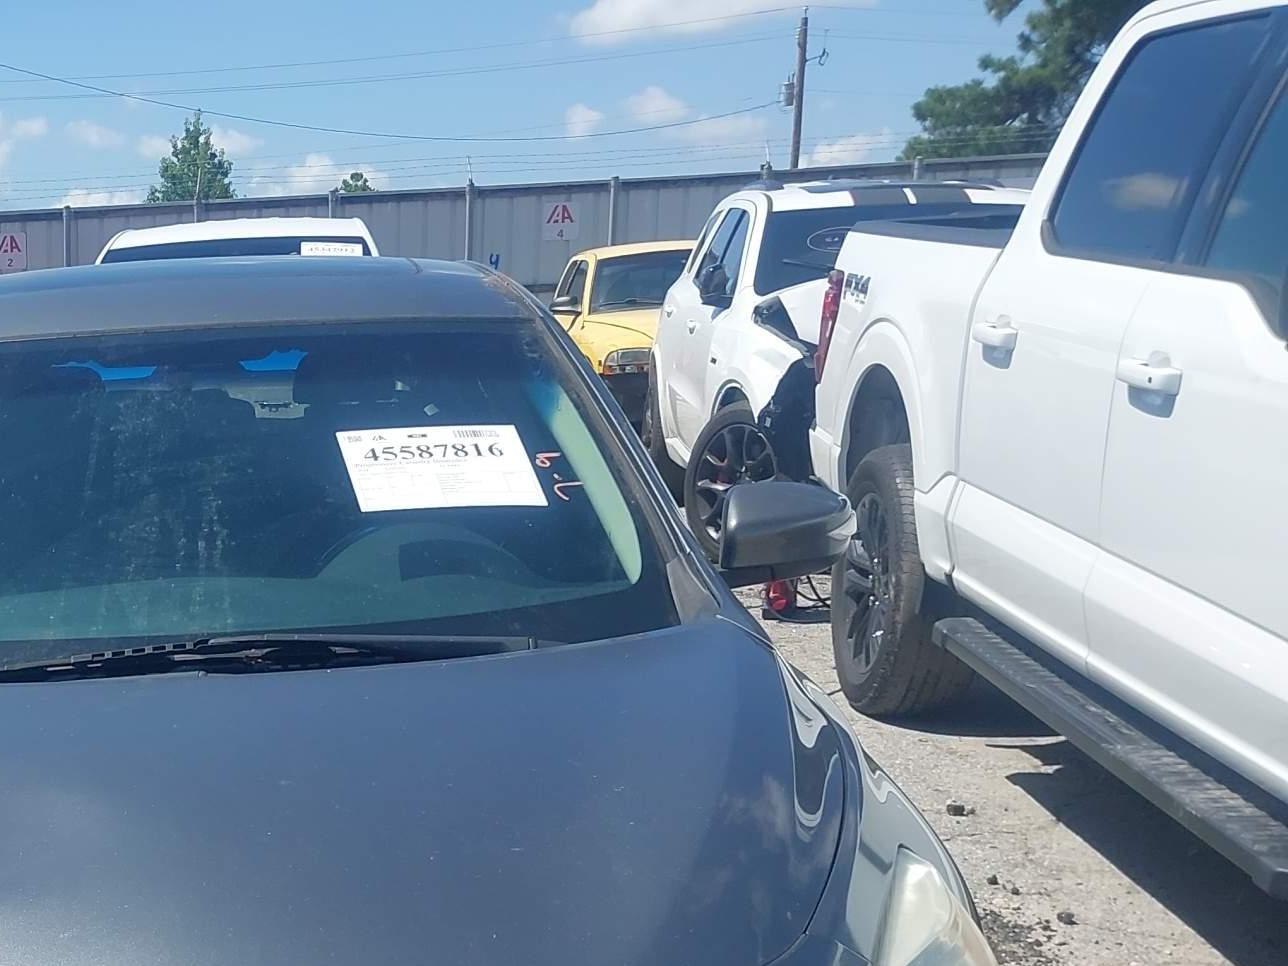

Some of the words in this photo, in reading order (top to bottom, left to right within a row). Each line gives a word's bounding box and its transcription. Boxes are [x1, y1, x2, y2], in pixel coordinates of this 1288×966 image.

[556, 229, 564, 238] 4
[7, 258, 14, 268] 2
[364, 441, 504, 461] 45587816
